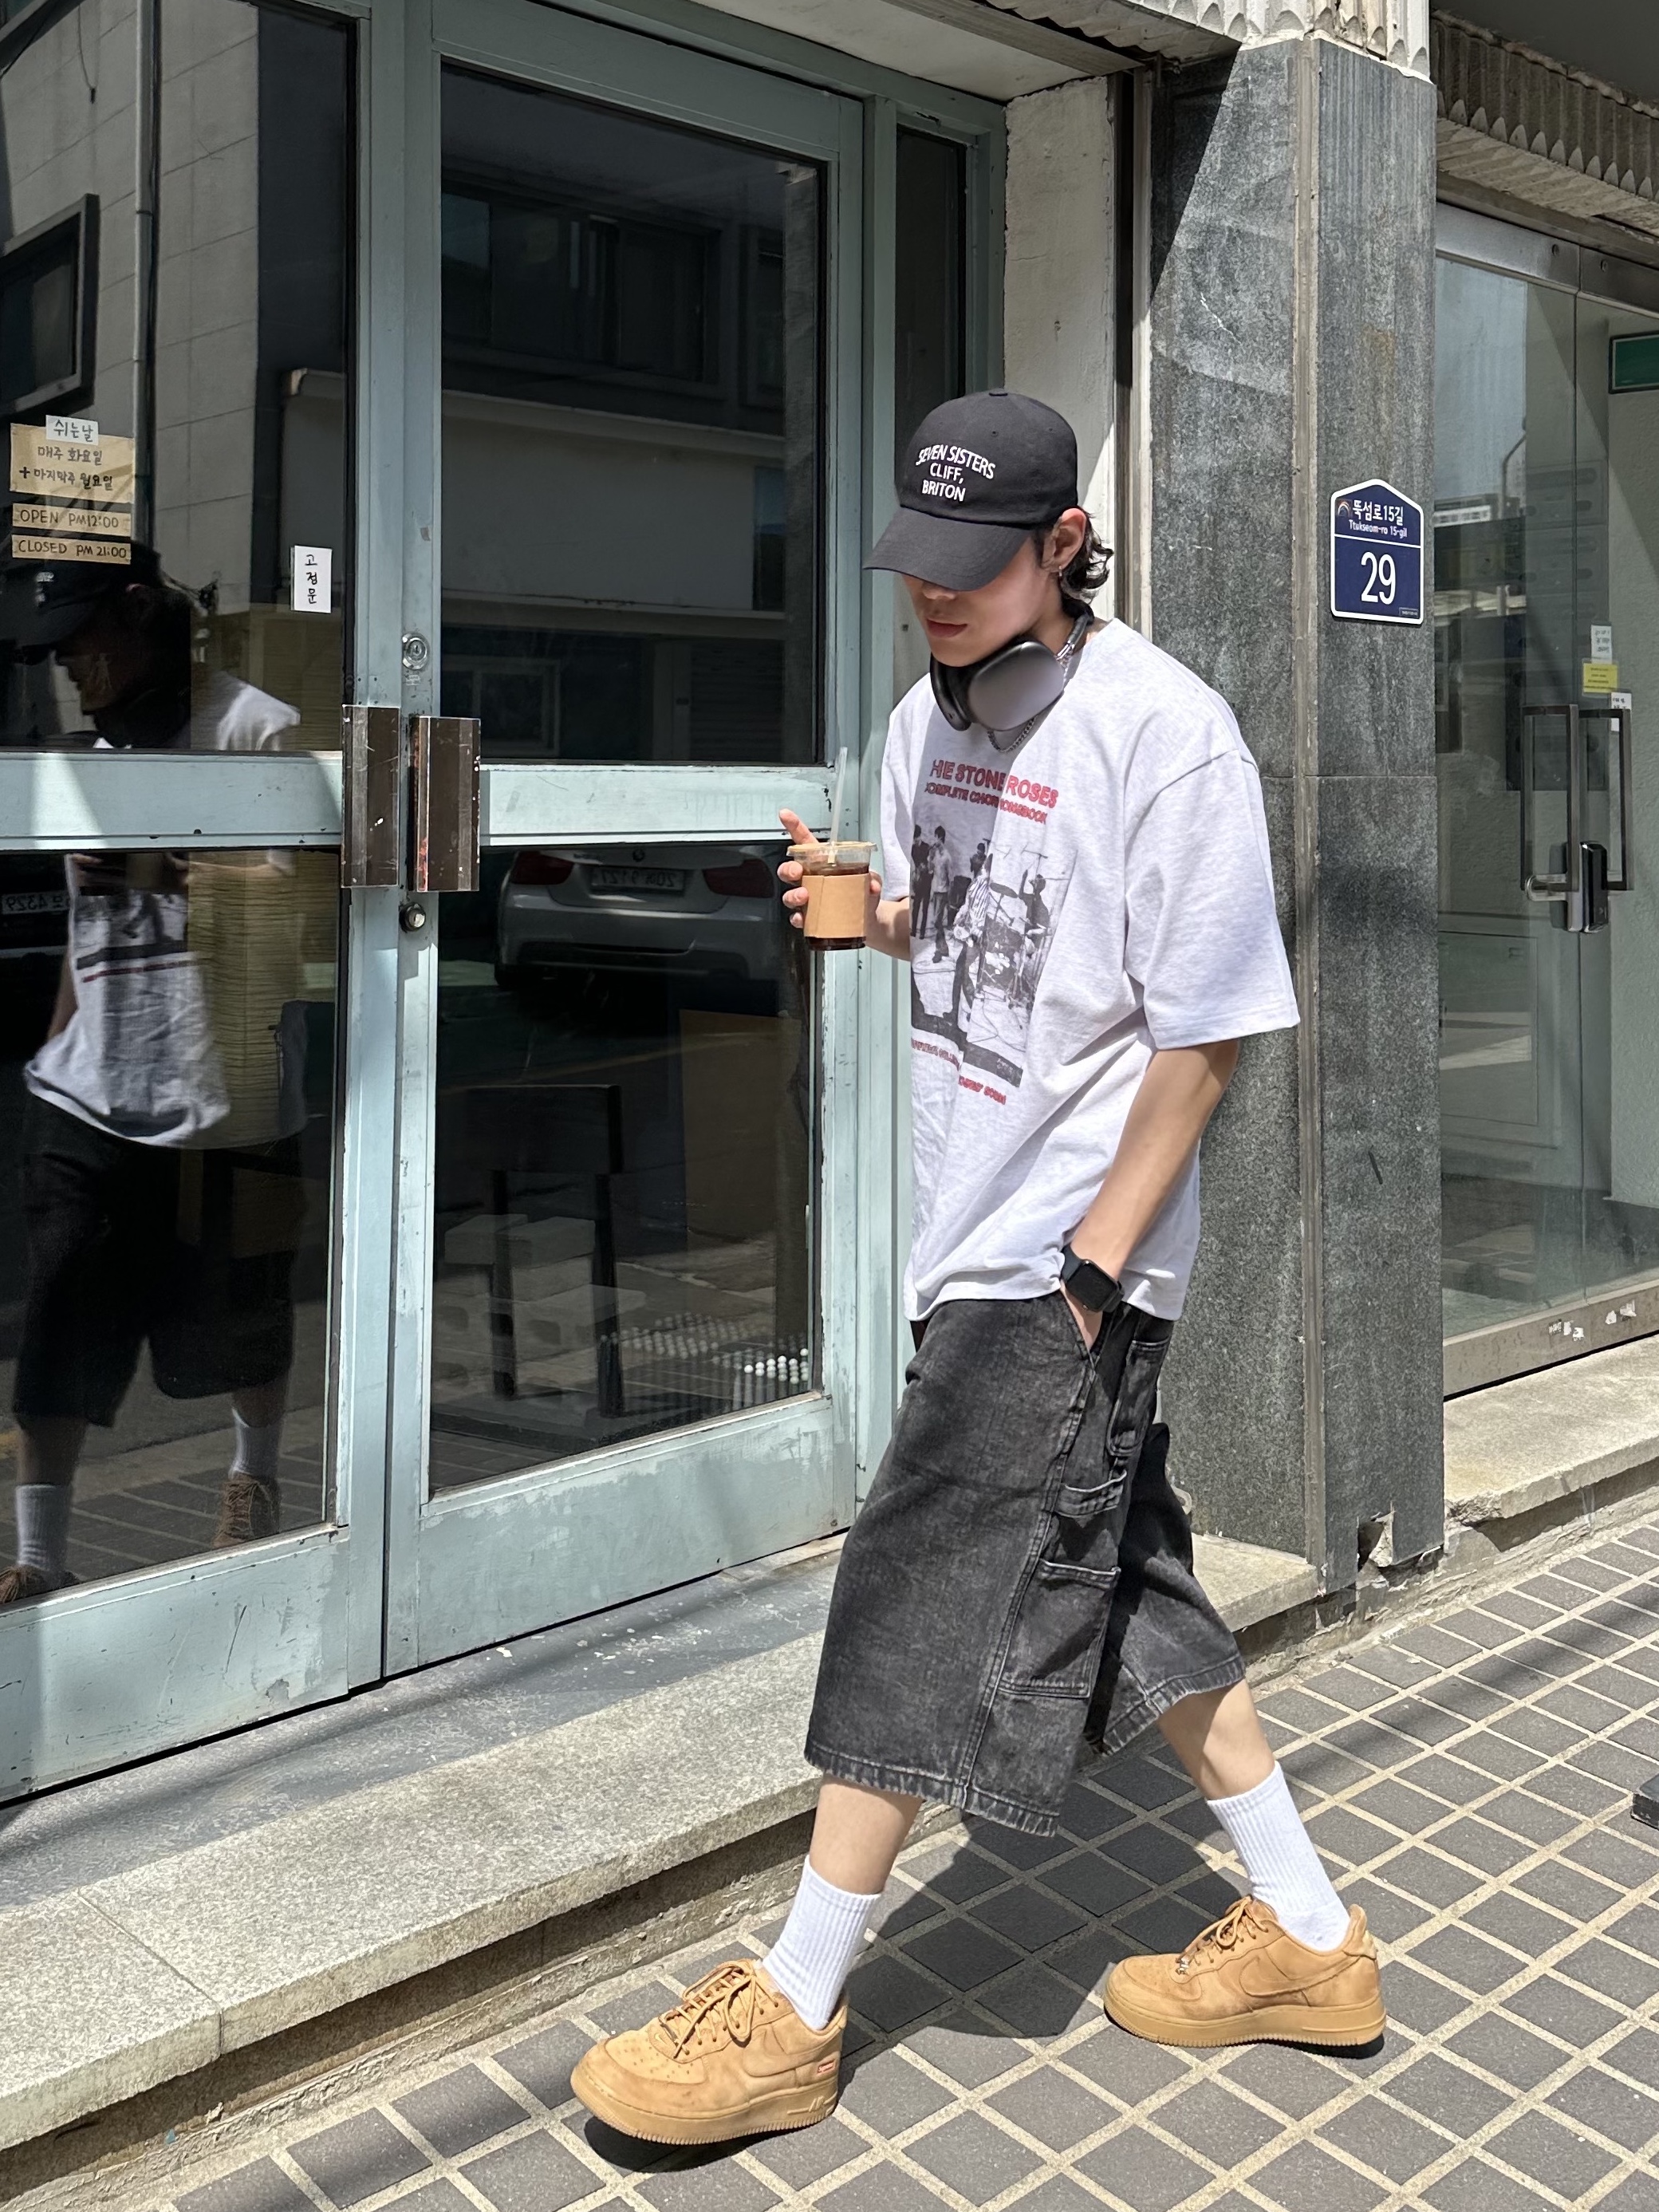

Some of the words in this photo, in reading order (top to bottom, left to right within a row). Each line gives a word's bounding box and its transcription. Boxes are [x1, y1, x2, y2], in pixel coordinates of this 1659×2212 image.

[53, 419, 94, 443] 쉬는날
[37, 445, 64, 460] 매주
[68, 448, 103, 466] 화요일
[915, 444, 946, 466] SEVEN
[947, 445, 996, 480] SISTERS
[80, 472, 113, 491] 월요일
[930, 463, 964, 484] CLIFF,
[922, 479, 966, 502] BRITON
[20, 509, 59, 523] OPEN
[1352, 499, 1404, 526] 뚝섬로15길
[1349, 519, 1389, 535] Ttukseom-ro
[18, 540, 67, 554] CLOSED
[97, 546, 127, 558] 21:00
[305, 554, 318, 605] 고정문
[1361, 551, 1396, 605] 29
[929, 759, 956, 780] HE
[955, 763, 1007, 791] STONE
[1006, 775, 1059, 809] ROSES
